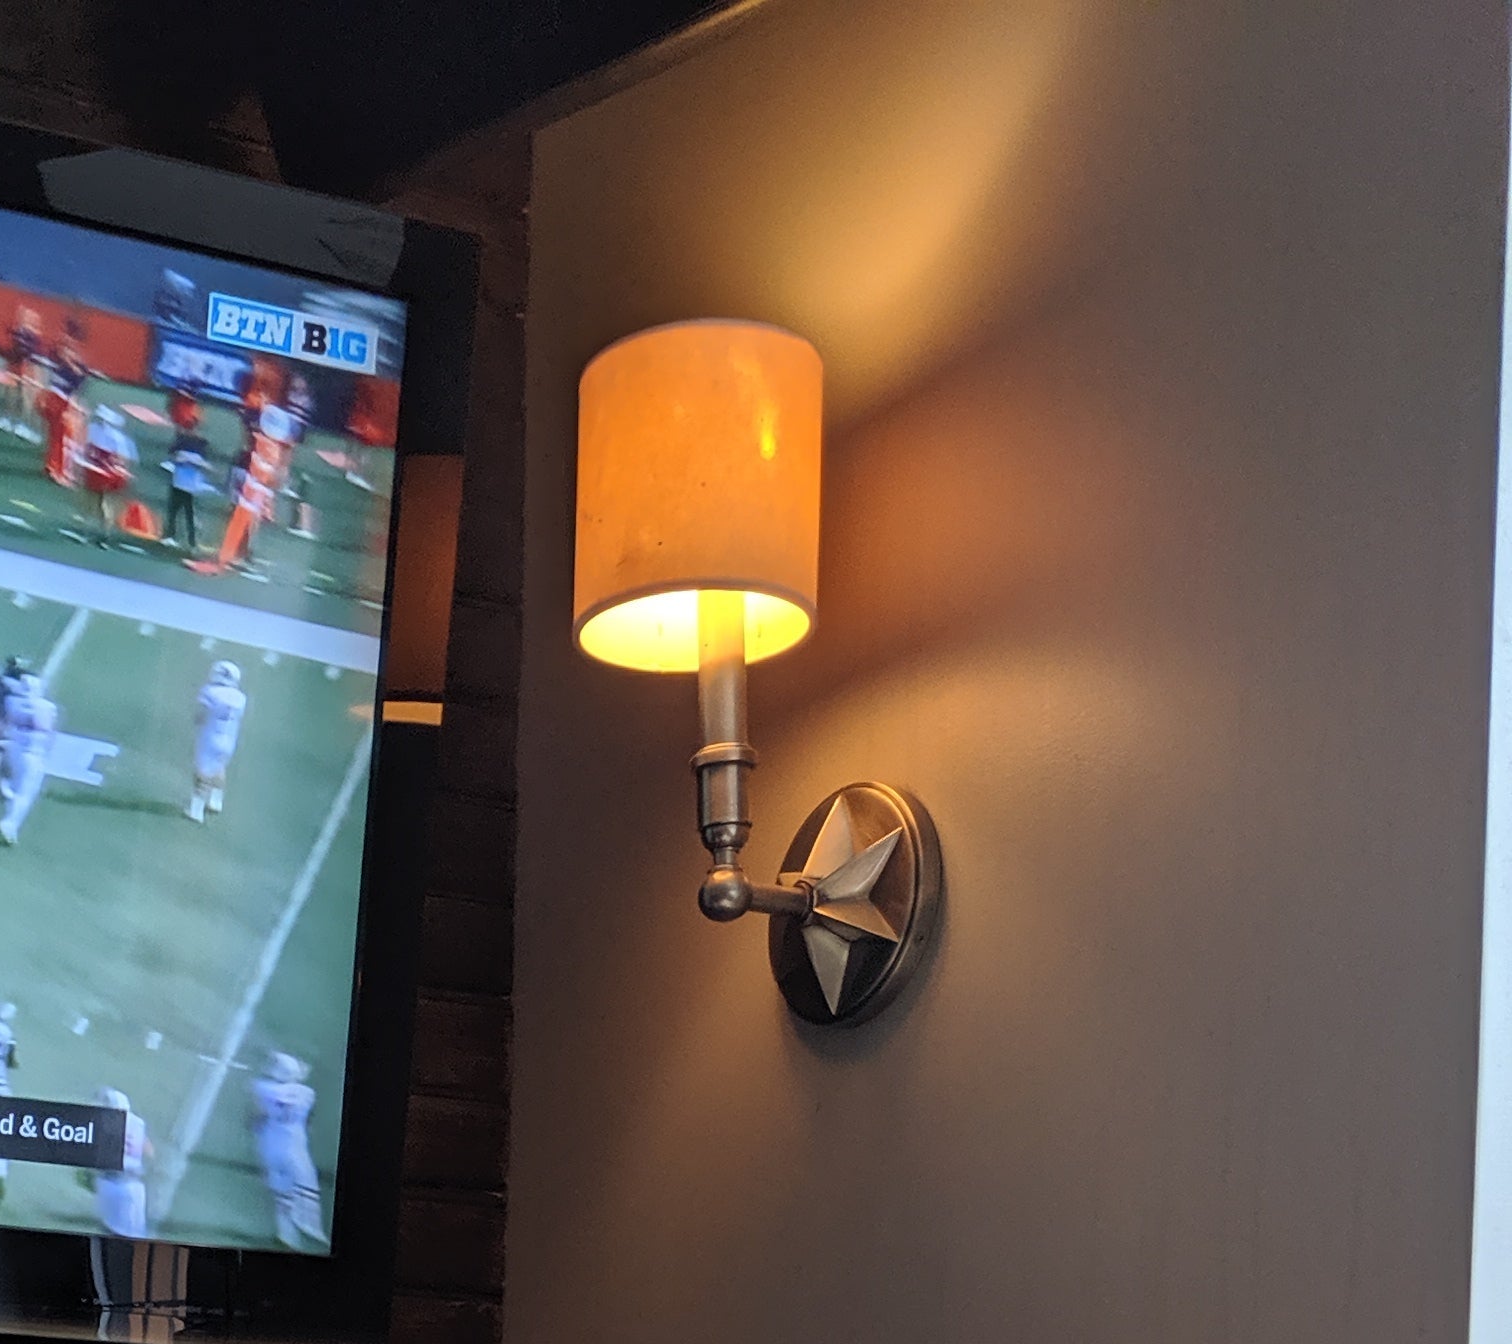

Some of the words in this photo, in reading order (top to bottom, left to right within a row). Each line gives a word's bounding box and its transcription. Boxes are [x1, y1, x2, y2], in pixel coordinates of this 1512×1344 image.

[214, 301, 291, 346] BTN
[19, 1114, 39, 1139] &
[43, 1116, 94, 1144] Goal
